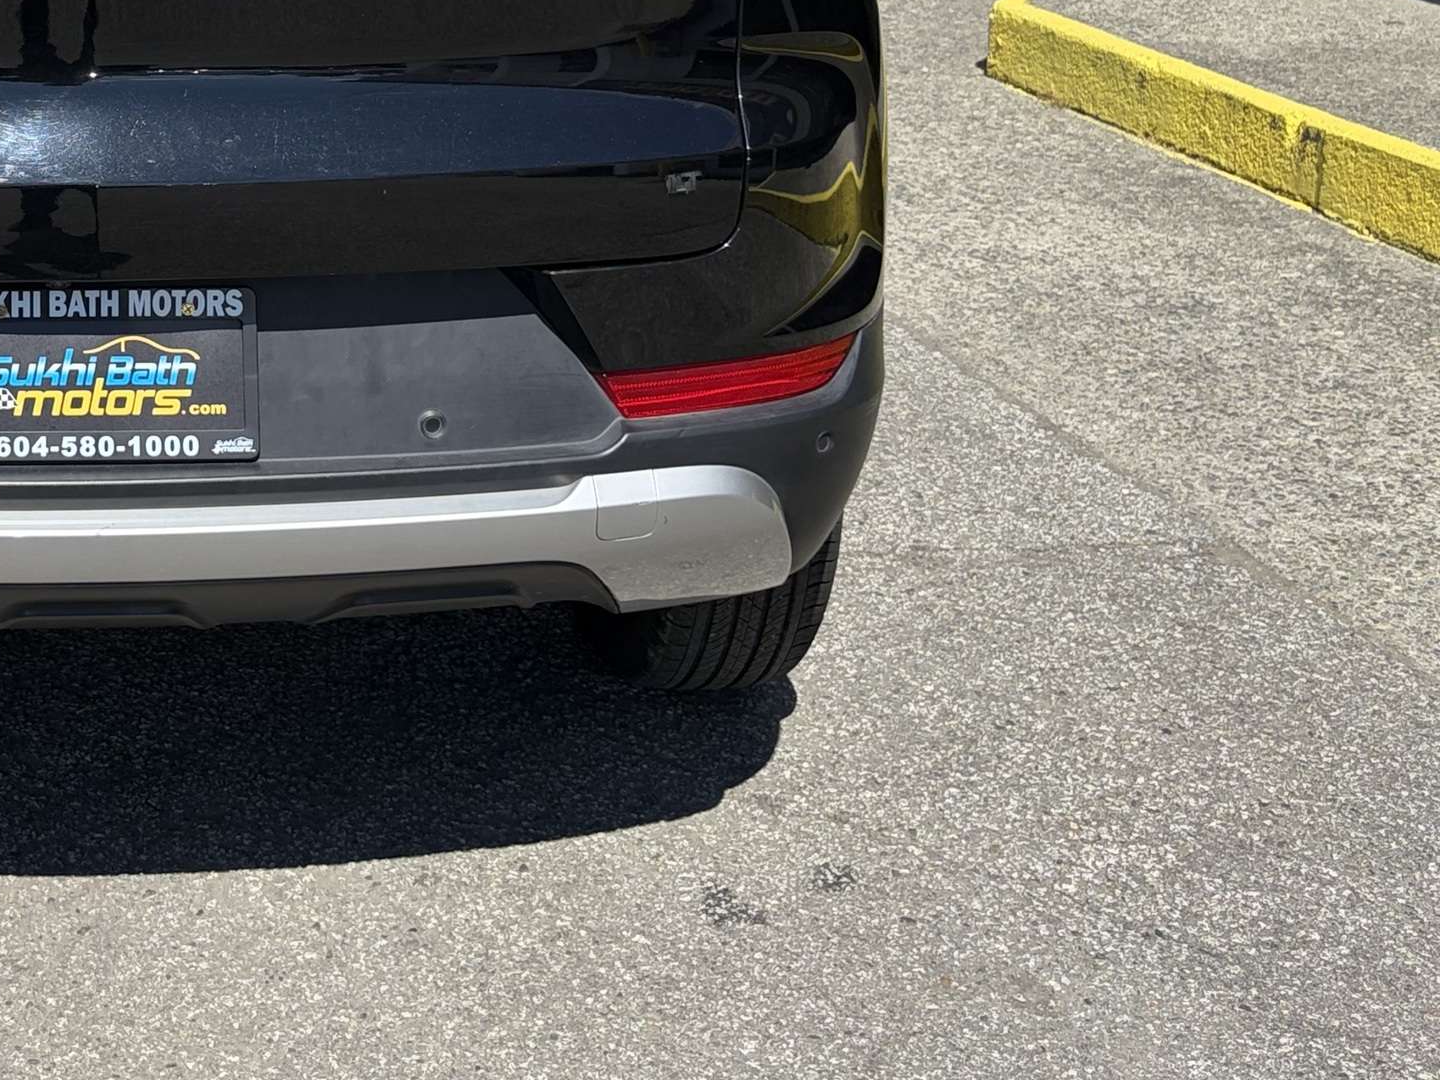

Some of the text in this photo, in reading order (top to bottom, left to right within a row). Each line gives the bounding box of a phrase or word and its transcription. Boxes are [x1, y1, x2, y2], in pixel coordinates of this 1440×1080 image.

[48, 290, 120, 318] BATH
[127, 289, 244, 317] MOTORS
[105, 355, 198, 386] Bath
[12, 377, 227, 416] motors.com
